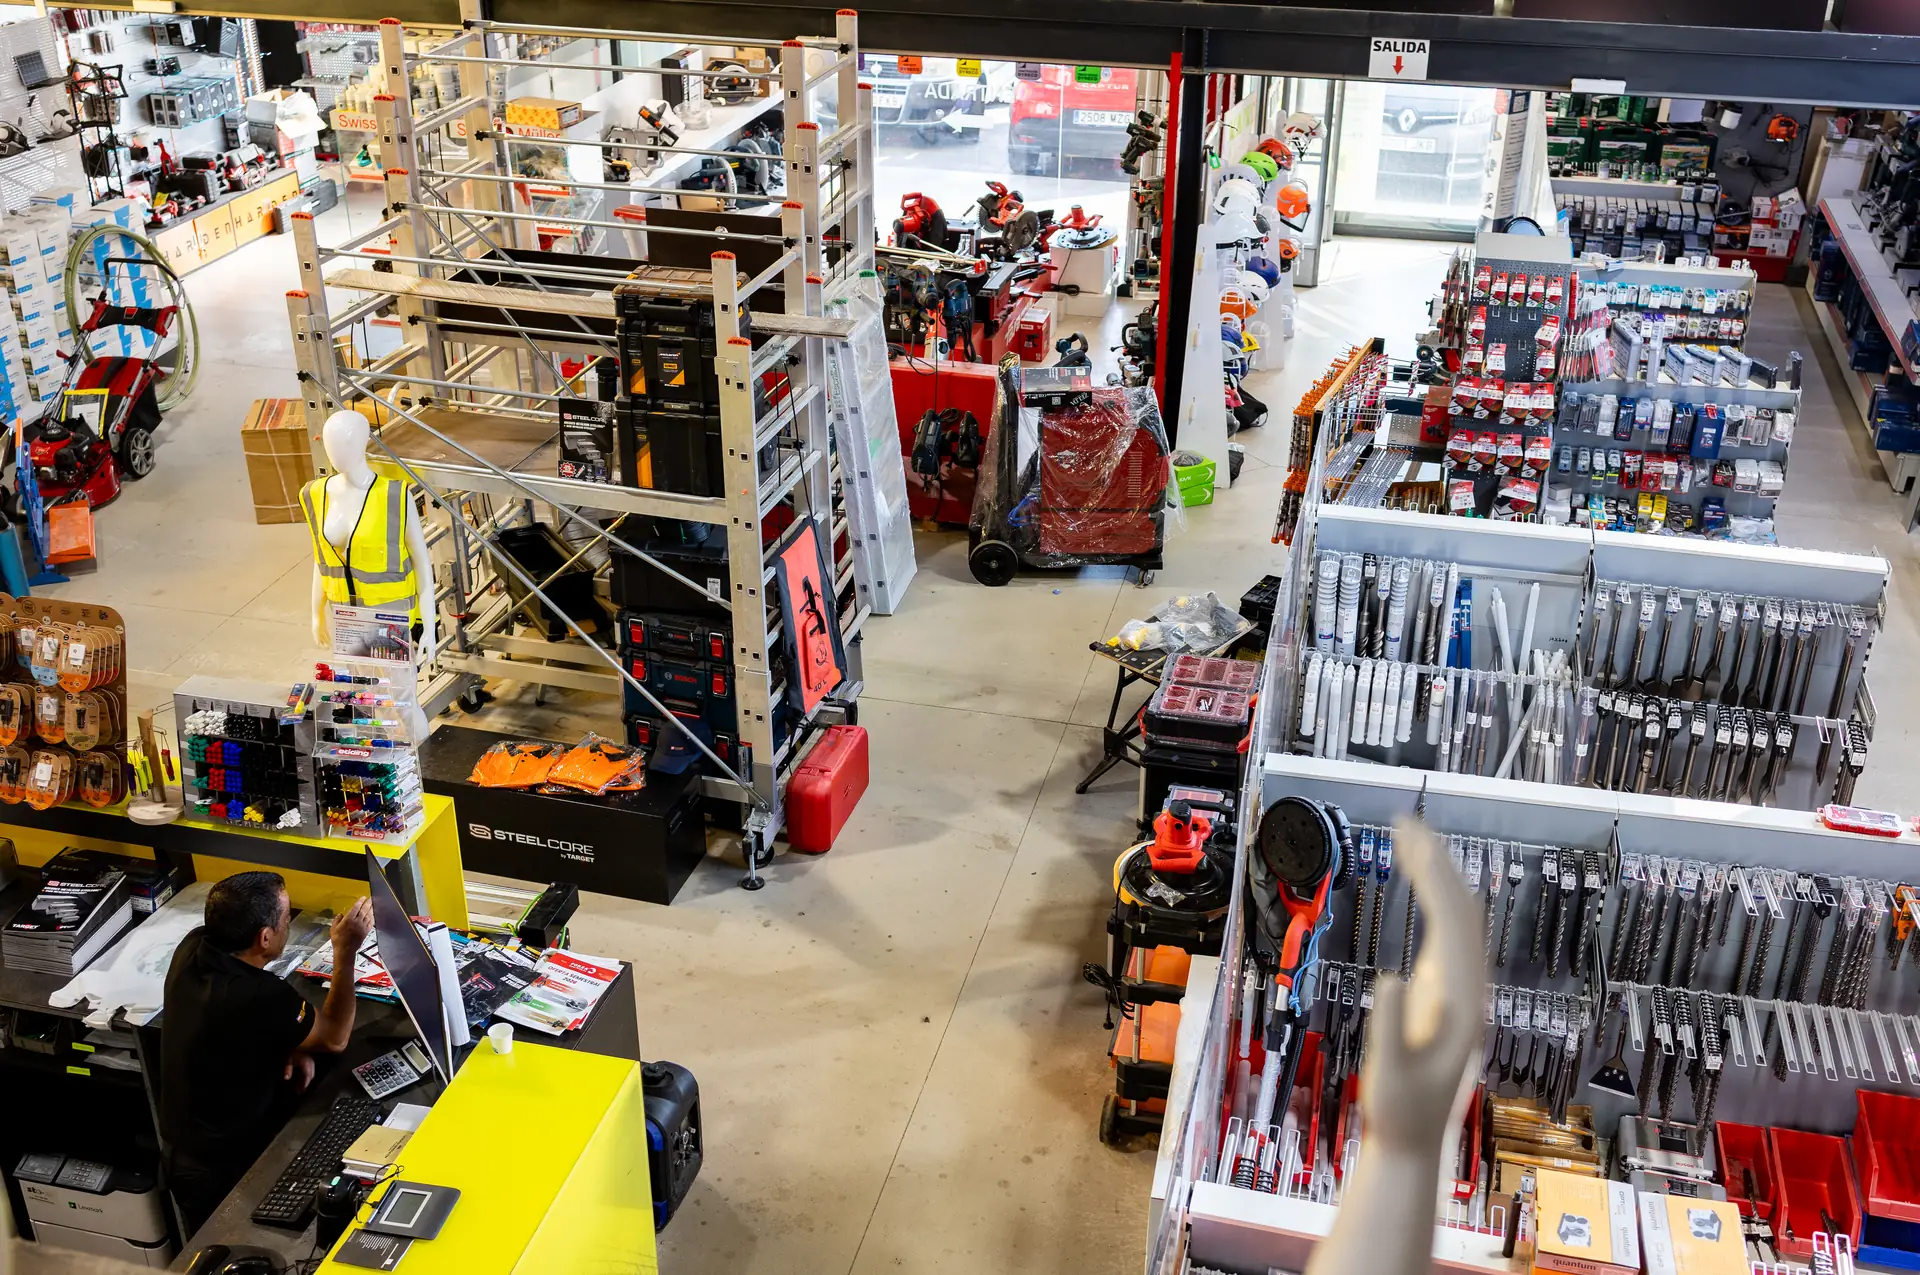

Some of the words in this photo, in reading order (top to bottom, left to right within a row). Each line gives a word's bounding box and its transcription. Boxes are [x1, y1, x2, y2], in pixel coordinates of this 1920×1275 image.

[1372, 40, 1428, 54] SALIDA
[338, 115, 377, 130] Swiss
[1080, 112, 1106, 123] 2508
[337, 747, 371, 758] edding
[352, 829, 385, 839] edding
[493, 829, 595, 856] STEELCORE
[566, 853, 595, 863] TARGET
[78, 1203, 104, 1213] Lexmark
[1620, 1226, 1633, 1257] quantum
[1552, 1258, 1597, 1271] quantum
